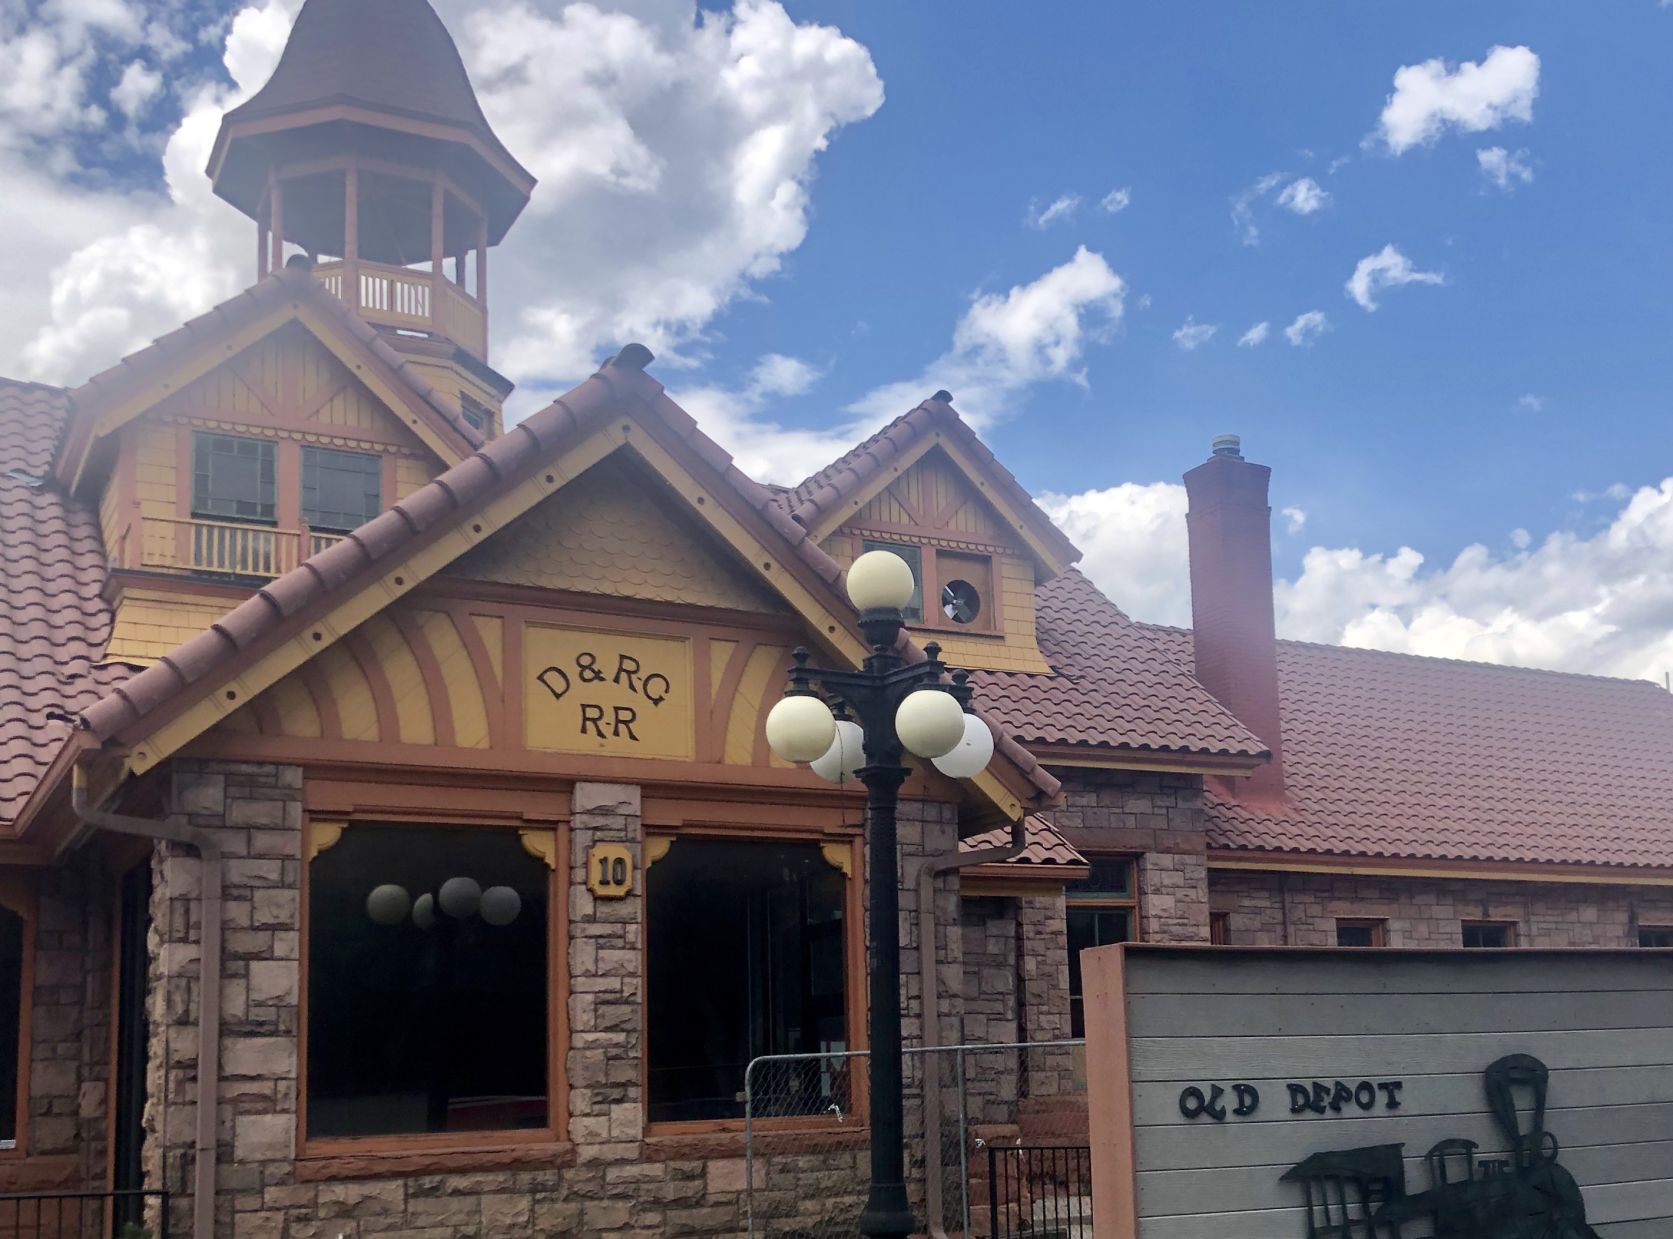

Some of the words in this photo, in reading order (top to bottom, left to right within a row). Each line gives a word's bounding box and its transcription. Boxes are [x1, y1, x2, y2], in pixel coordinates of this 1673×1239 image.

[598, 856, 627, 886] 10
[1179, 1083, 1260, 1121] OLD
[1286, 1080, 1403, 1115] DEPOT
